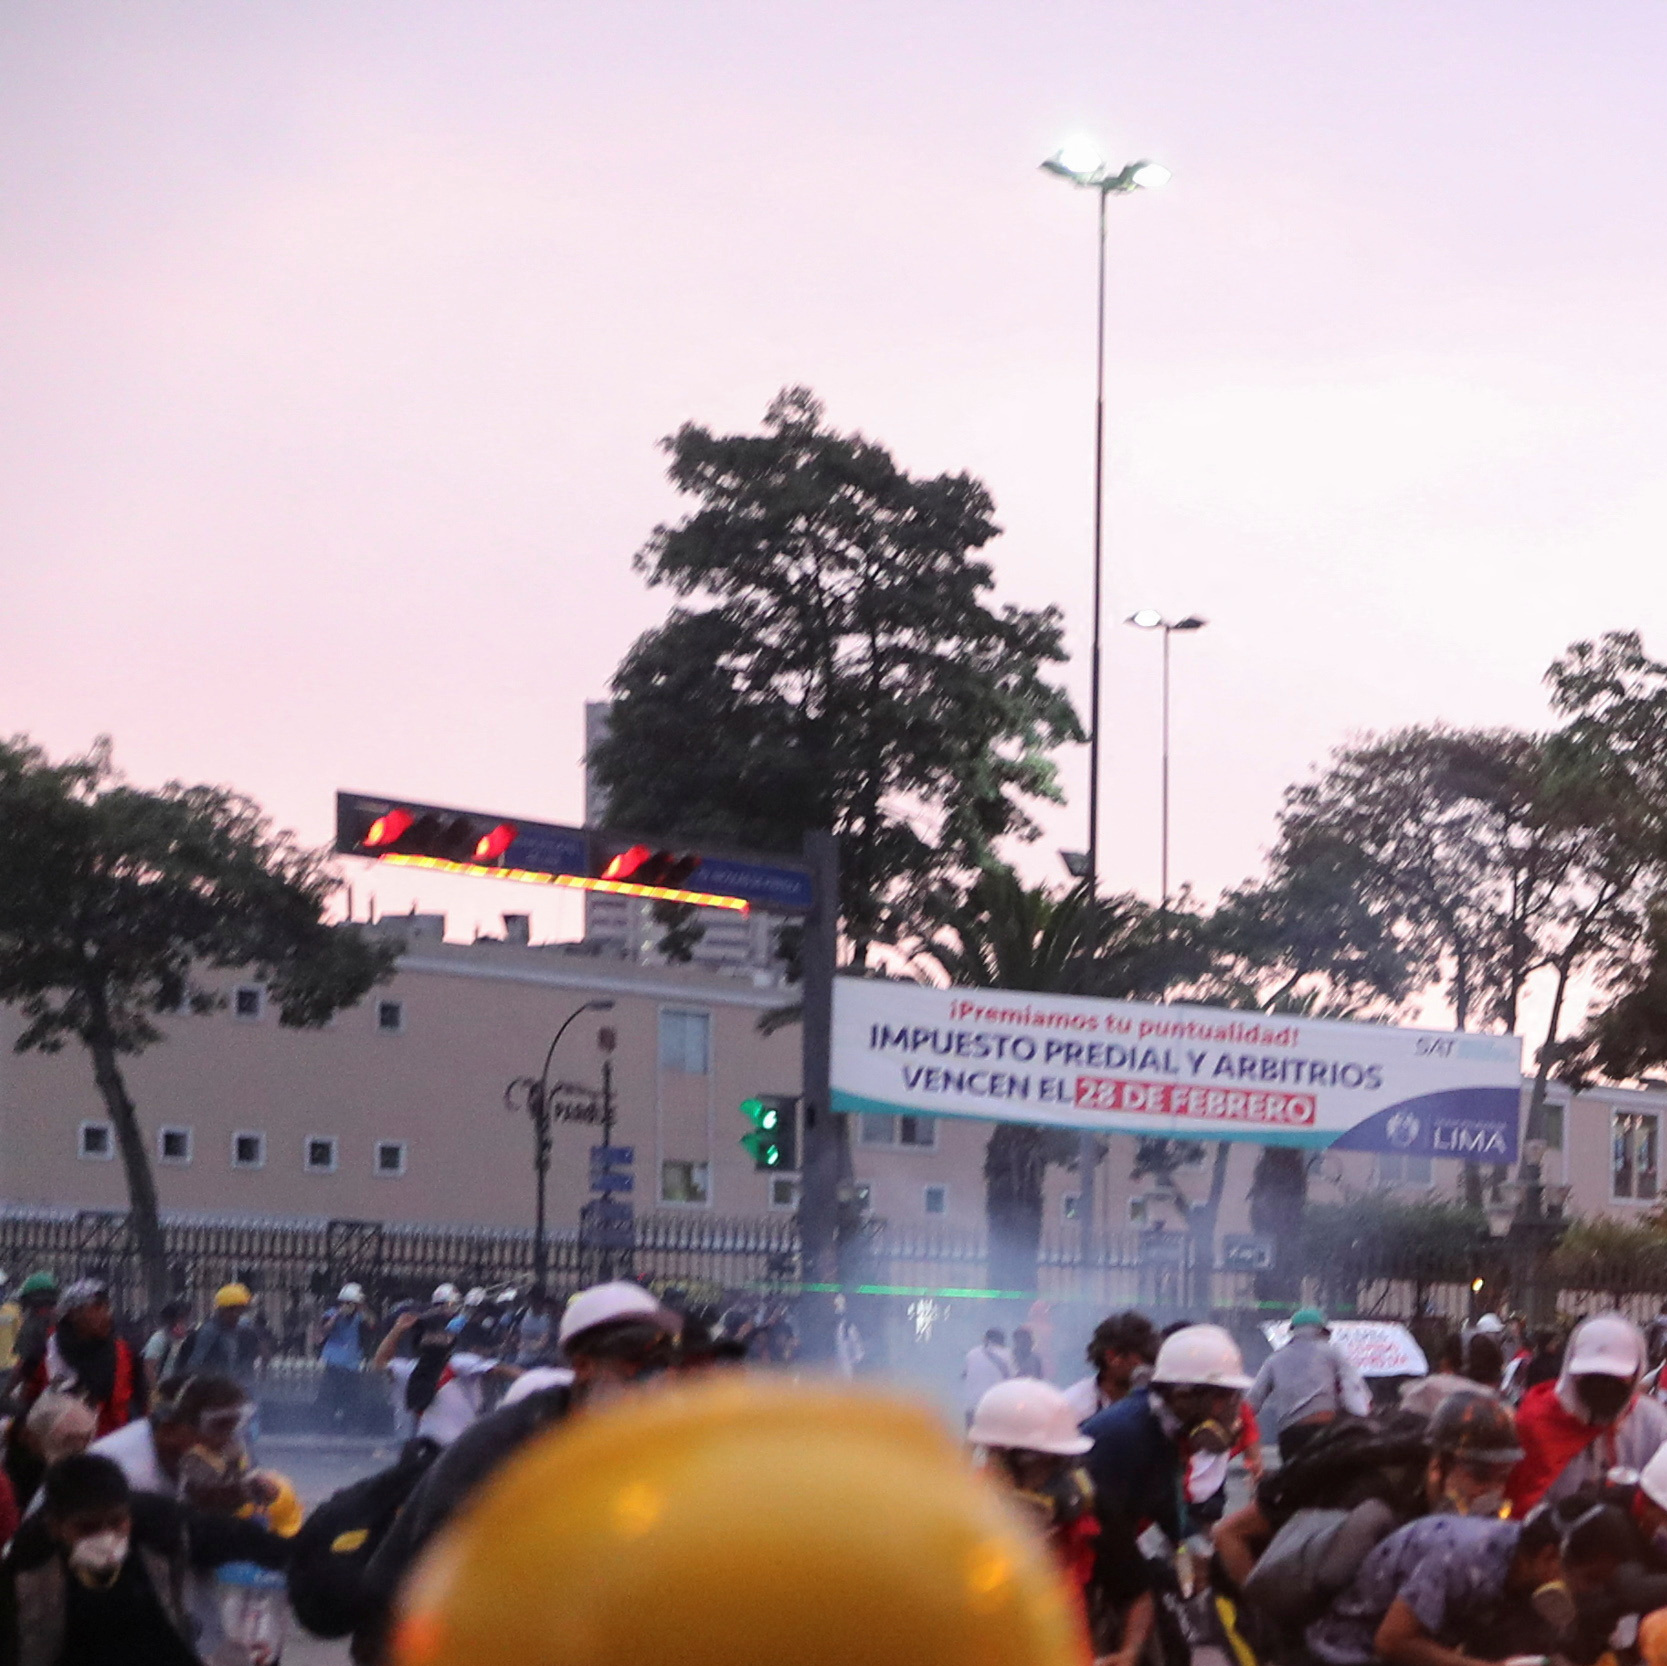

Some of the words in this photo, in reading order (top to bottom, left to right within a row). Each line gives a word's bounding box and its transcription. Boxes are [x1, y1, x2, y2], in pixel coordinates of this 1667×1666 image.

[1105, 1013, 1132, 1034] tu
[1138, 1018, 1300, 1048] puntualidad!
[1415, 1036, 1457, 1059] SAT
[869, 1022, 1037, 1063] IMPUESTO
[1042, 1038, 1179, 1076] PREDIAL
[1184, 1050, 1206, 1076] Y
[1211, 1052, 1385, 1091] ARBITRIOS
[902, 1064, 1030, 1100] VENCEN
[1038, 1077, 1073, 1105] EL
[1121, 1082, 1166, 1113] DE
[1169, 1085, 1314, 1124] FEBRERO
[1433, 1126, 1508, 1155] LIMA
